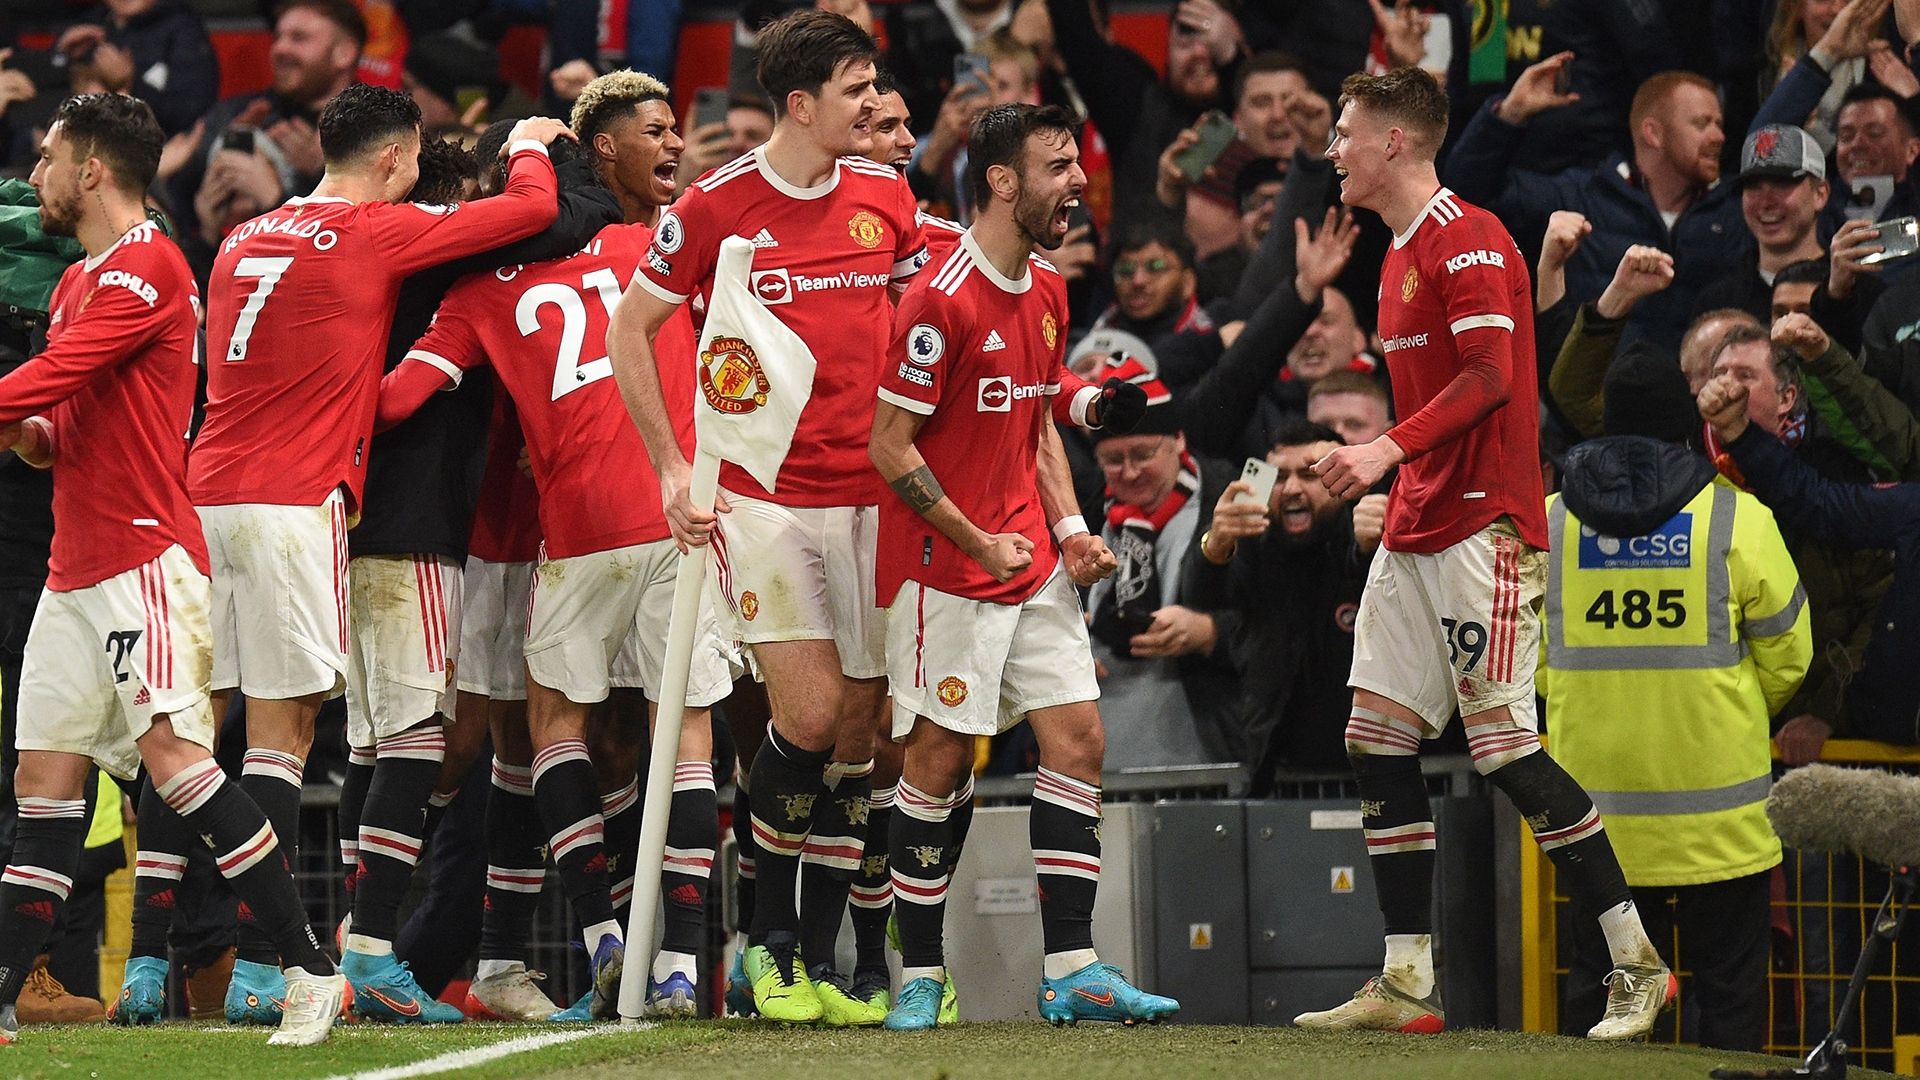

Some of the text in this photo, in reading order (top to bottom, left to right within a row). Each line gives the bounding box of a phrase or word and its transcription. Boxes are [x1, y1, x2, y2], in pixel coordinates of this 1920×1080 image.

[224, 217, 338, 251] RONALDO
[1445, 249, 1506, 275] KOHLER
[98, 270, 159, 308] KOHLER
[791, 271, 891, 293] TeamViewer
[226, 256, 295, 362] 7
[715, 340, 767, 387] MANCHESTER
[907, 366, 932, 380] room
[703, 381, 742, 411] UNITED
[1628, 532, 1689, 557] CSG
[1585, 589, 1687, 629] 485
[1441, 617, 1487, 672] 39
